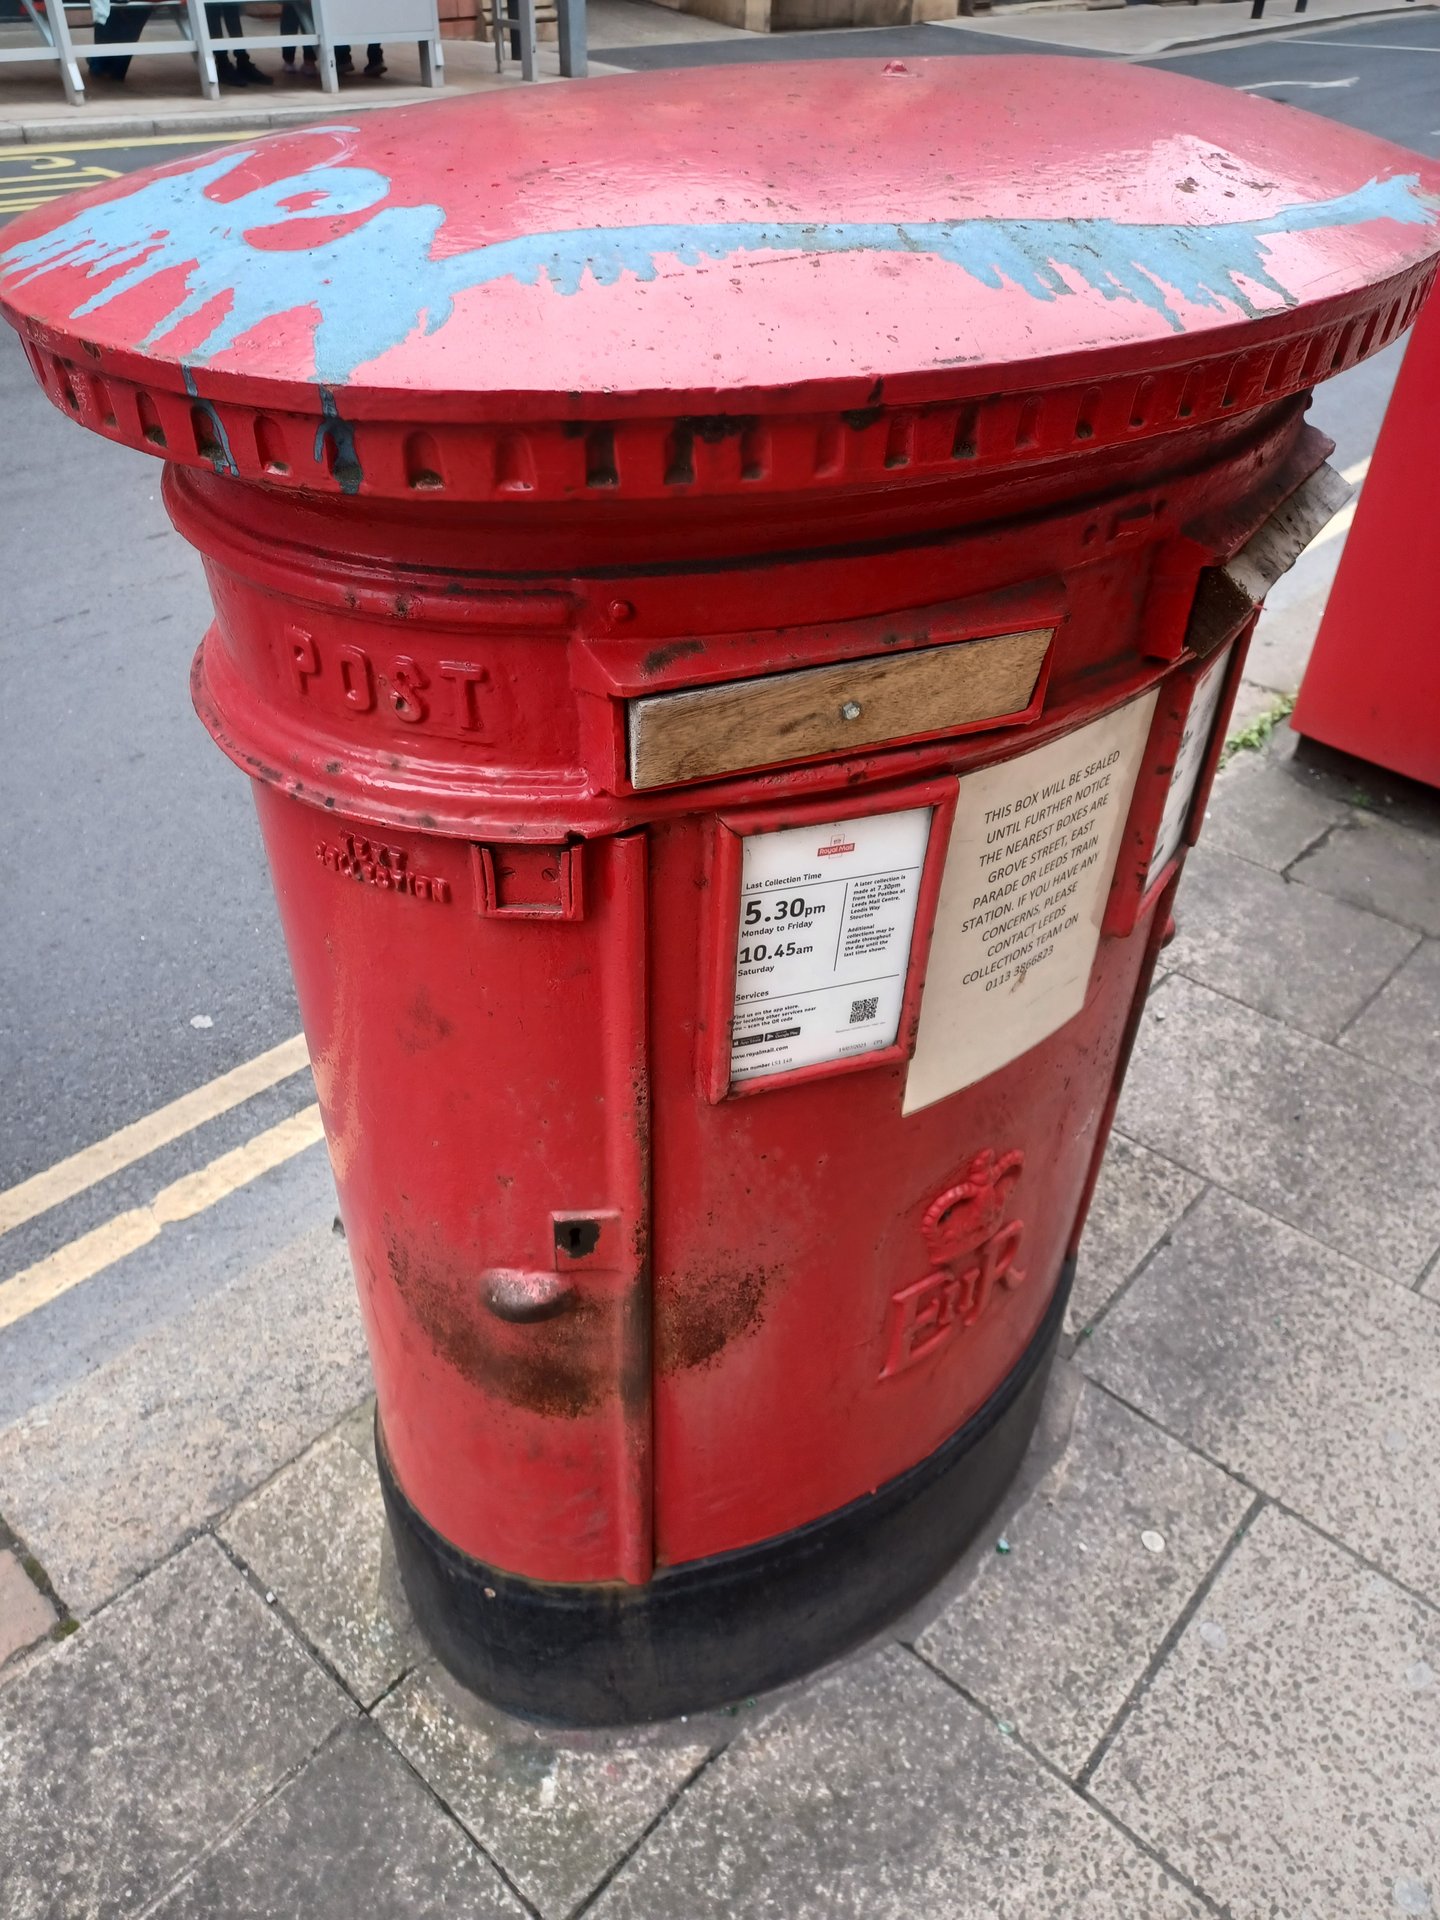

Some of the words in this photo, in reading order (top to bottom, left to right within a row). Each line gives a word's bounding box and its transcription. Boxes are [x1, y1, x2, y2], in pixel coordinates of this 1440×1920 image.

[290, 624, 489, 731] POST
[985, 804, 1012, 824] THIS
[1015, 792, 1039, 812] BOX
[1042, 779, 1066, 799] WILL
[1069, 770, 1082, 786] BE
[1084, 750, 1120, 778] SEALED
[987, 821, 1021, 844] UNTIL
[1024, 795, 1072, 828] FURTHER
[1075, 774, 1111, 802] NOTICE
[839, 844, 853, 852] Mail
[980, 849, 1002, 867] THE
[1006, 824, 1055, 857] NEAREST
[1056, 805, 1088, 831] BOXES
[1090, 793, 1109, 813] ARE
[988, 857, 1028, 883] GROVE
[1030, 835, 1068, 865] STREET,
[1071, 819, 1096, 841] EAST
[315, 840, 452, 903] COLLECTION
[746, 882, 762, 890] Last
[765, 876, 801, 887] Collection
[874, 876, 899, 884] collection
[961, 902, 1013, 932] STATION.
[1018, 894, 1027, 907] IF
[1030, 880, 1050, 900] YOU
[1053, 864, 1078, 887] HAVE
[1080, 851, 1099, 871] ANY
[973, 879, 1019, 909] PARADE
[1021, 870, 1036, 886] OR
[1039, 852, 1068, 878] LEEDS
[1071, 835, 1098, 859] TRAIN
[742, 927, 774, 938] Monday
[788, 921, 813, 930] Friday
[745, 898, 825, 924] 5.30pm
[848, 924, 874, 932] Additional
[982, 904, 1040, 941] CONCERNS,
[1044, 881, 1078, 908] PLEASE
[987, 922, 1036, 956] CONTACT
[1038, 904, 1067, 929] LEEDS
[739, 942, 813, 964] 10.45am
[847, 930, 874, 939] collections
[862, 933, 891, 942] throughout
[962, 942, 1033, 985] COLLECTIONS
[1036, 923, 1062, 947] TEAM
[1064, 913, 1079, 929] ON
[738, 965, 774, 976] Saturday
[986, 970, 1011, 991] 0113
[1014, 945, 1054, 976] 3866823
[736, 991, 769, 1001] Services
